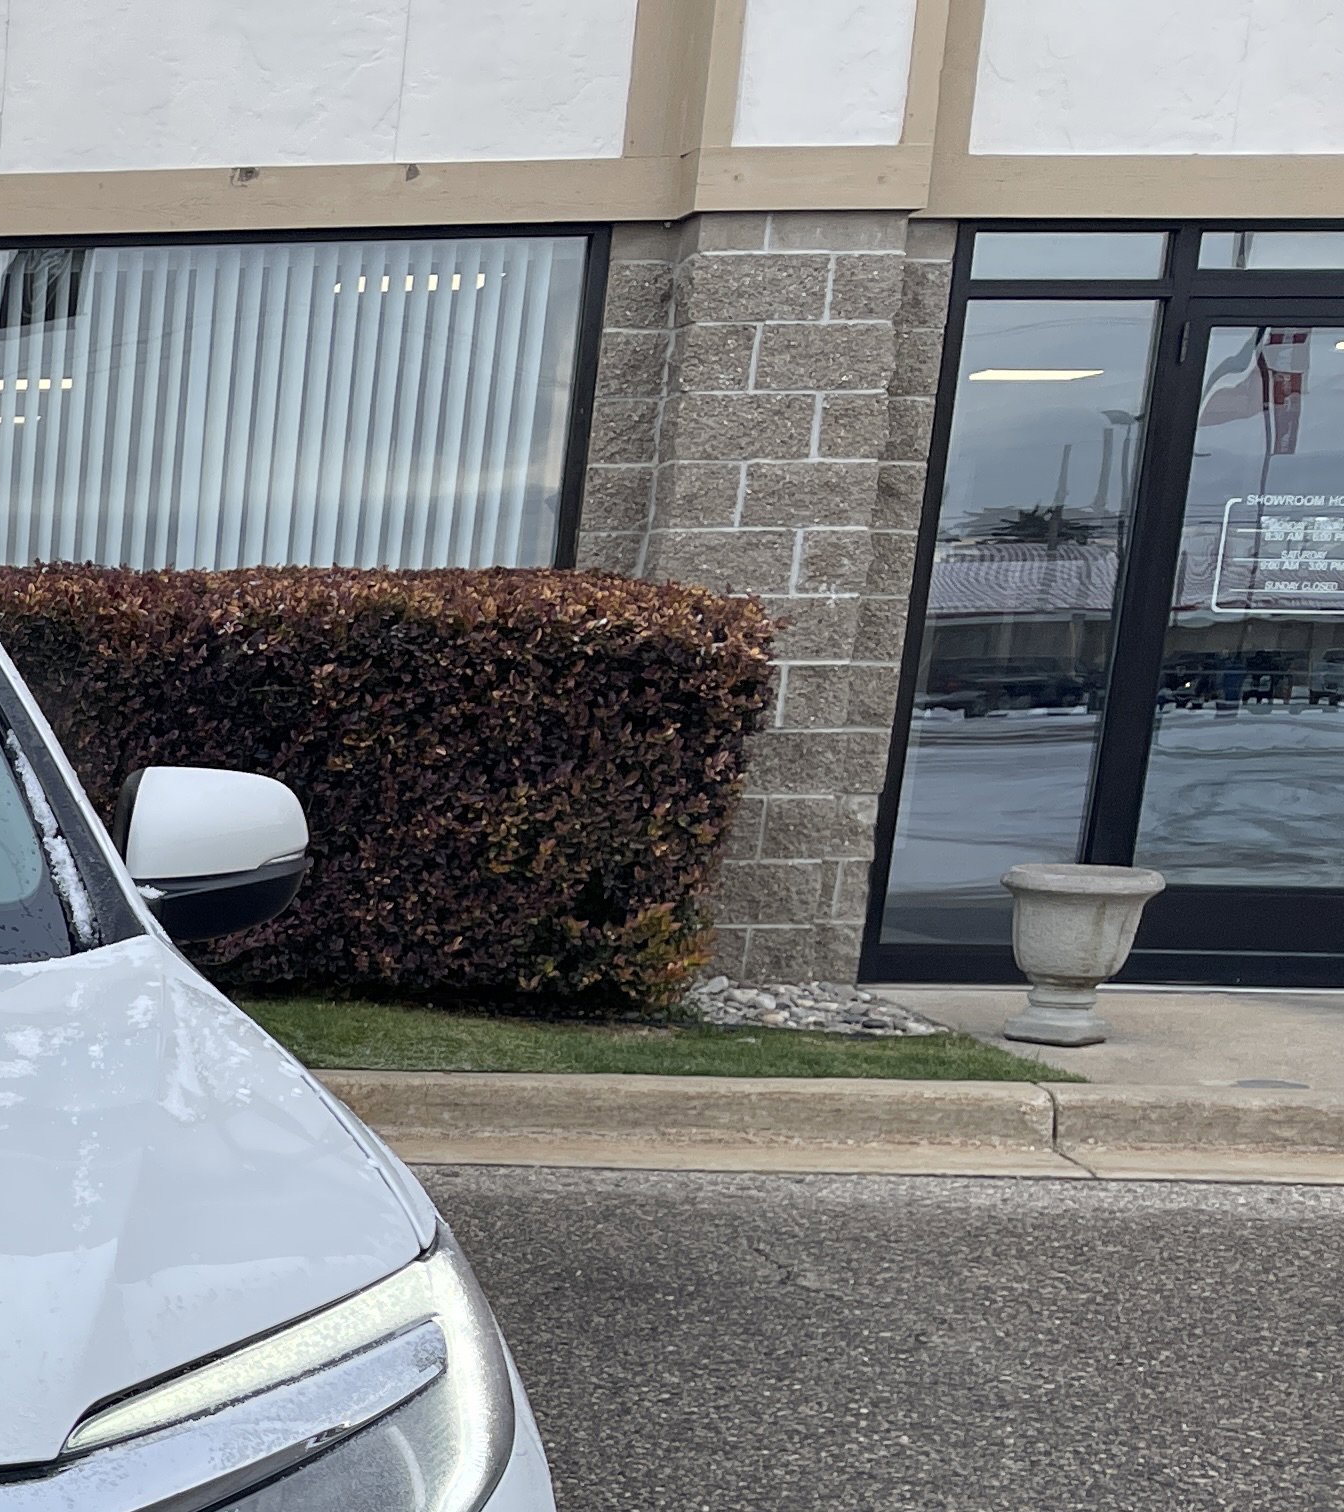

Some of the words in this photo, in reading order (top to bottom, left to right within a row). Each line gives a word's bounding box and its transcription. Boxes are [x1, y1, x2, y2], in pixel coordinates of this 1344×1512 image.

[1246, 495, 1326, 506] SHOWROOM
[1281, 550, 1327, 560] SATURDAY
[1265, 581, 1300, 590] SUNDAY
[1302, 581, 1338, 590] CLOSED
